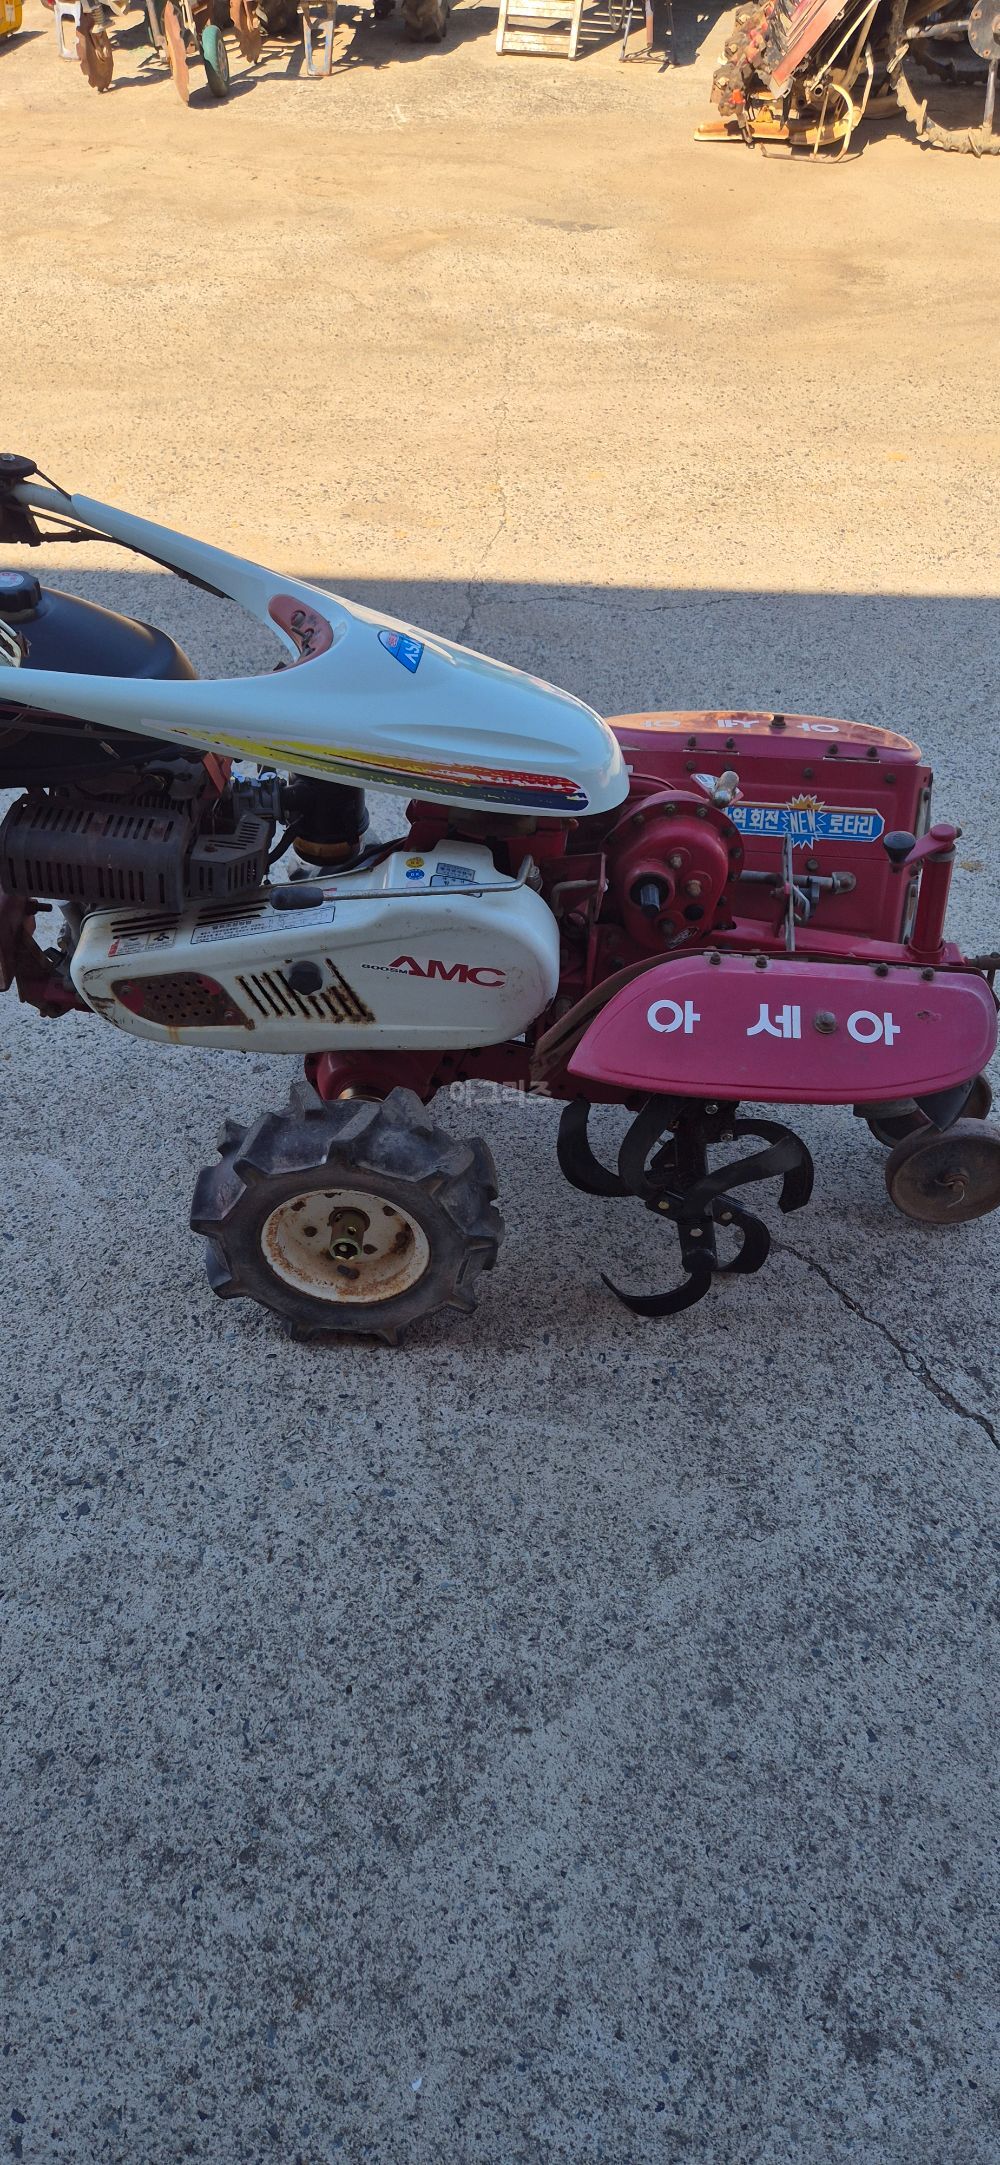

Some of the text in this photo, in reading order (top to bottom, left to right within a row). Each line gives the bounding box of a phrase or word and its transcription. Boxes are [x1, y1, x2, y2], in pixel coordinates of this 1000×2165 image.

[750, 809, 779, 830] 회전
[789, 809, 817, 834] NEW
[828, 814, 874, 836] 로타리
[389, 956, 507, 987] AMC
